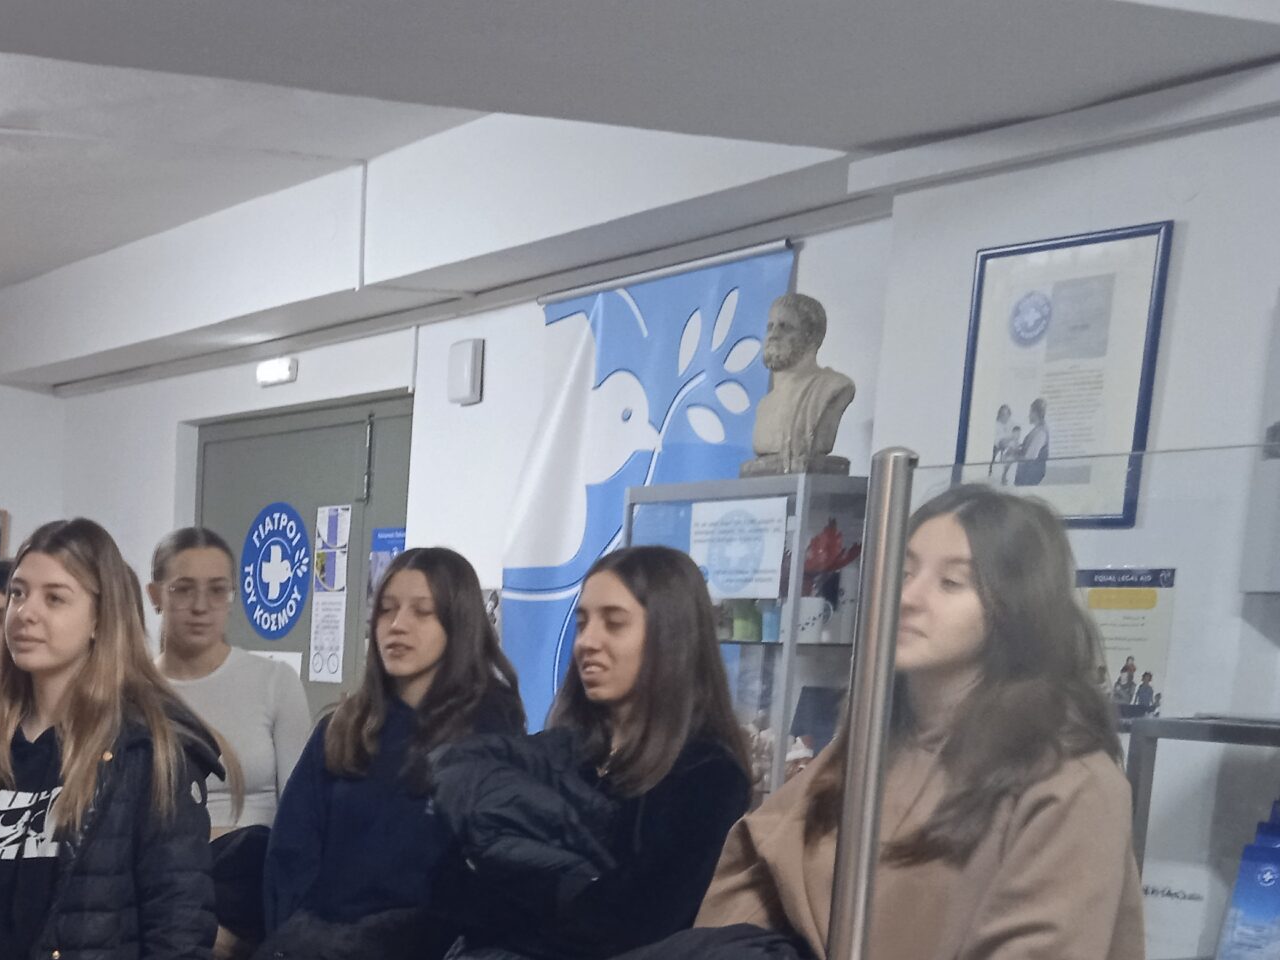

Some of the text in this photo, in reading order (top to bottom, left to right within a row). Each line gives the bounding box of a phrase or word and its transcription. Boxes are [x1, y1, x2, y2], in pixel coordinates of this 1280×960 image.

[252, 511, 302, 548] ΓΙΑΤΡΟΙ
[243, 562, 258, 605] ΤΟΥ
[253, 585, 302, 632] ΚΟΣΜΟΥ
